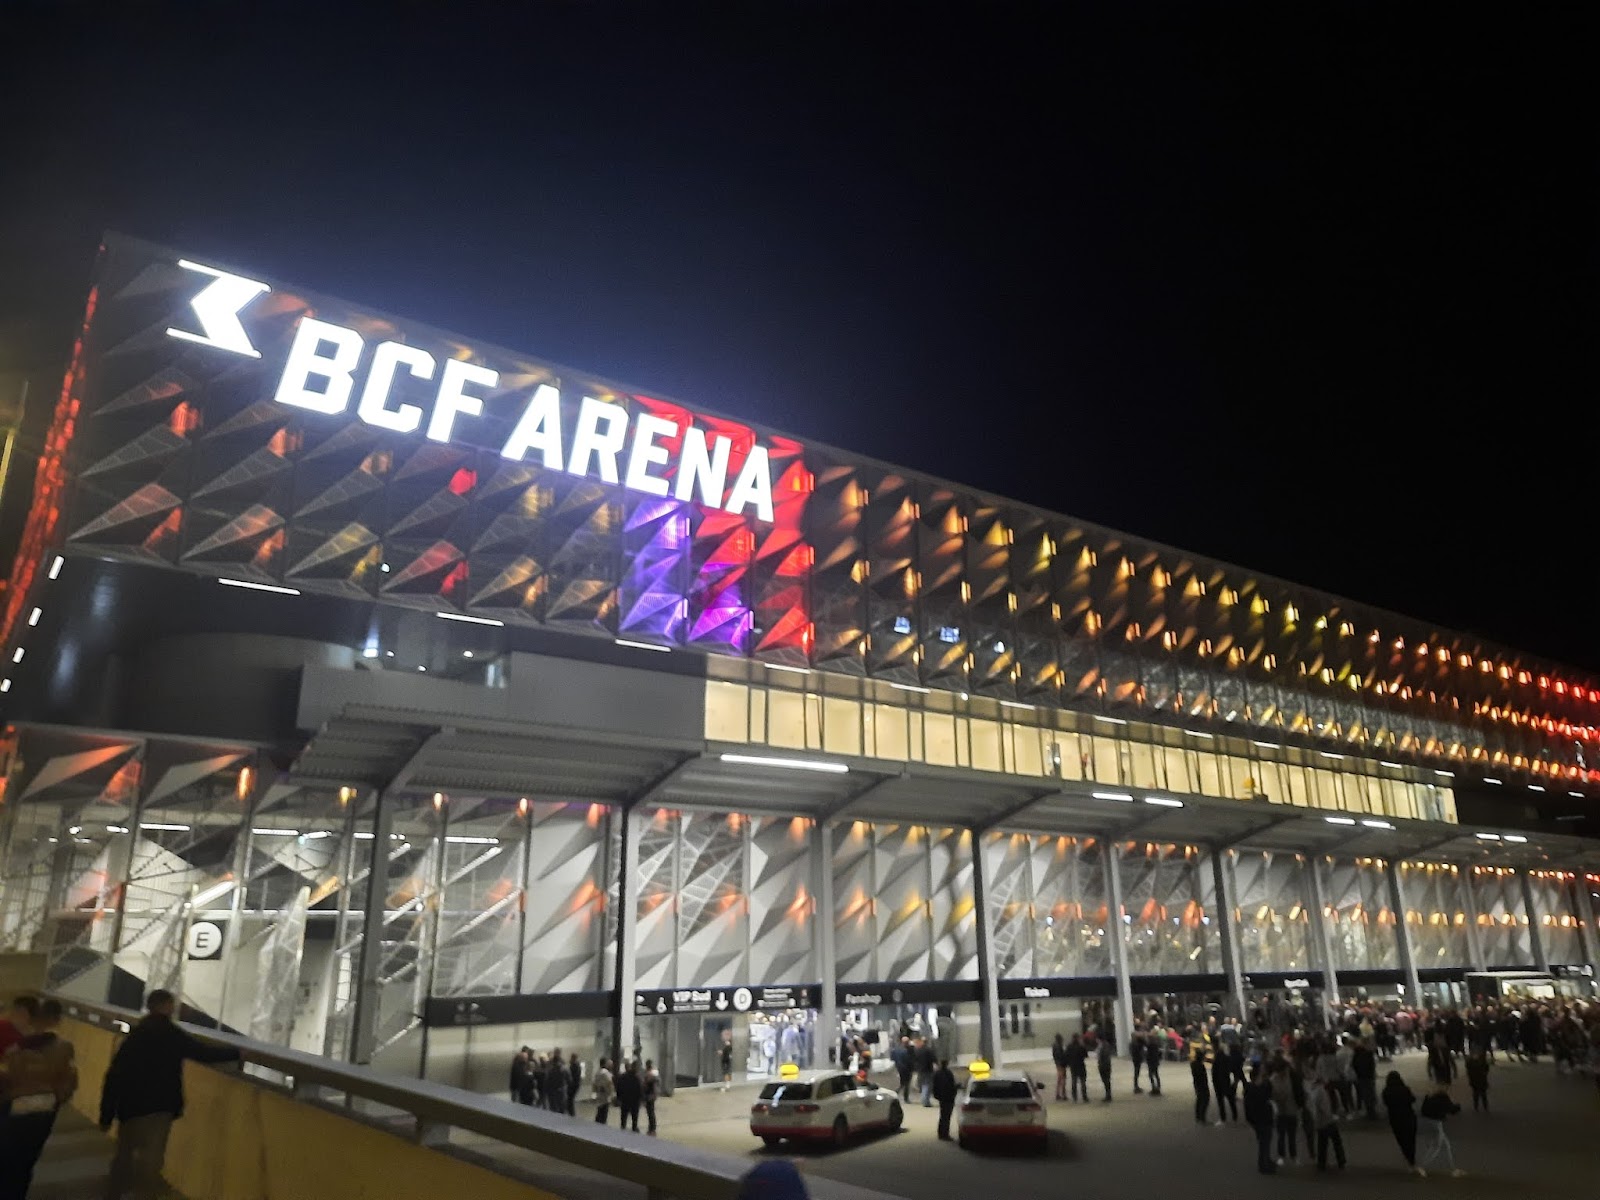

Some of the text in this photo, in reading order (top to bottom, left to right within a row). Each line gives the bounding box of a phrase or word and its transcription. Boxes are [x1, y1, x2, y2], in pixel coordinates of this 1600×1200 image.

[273, 316, 775, 523] BCF ARENA
[196, 931, 210, 948] E
